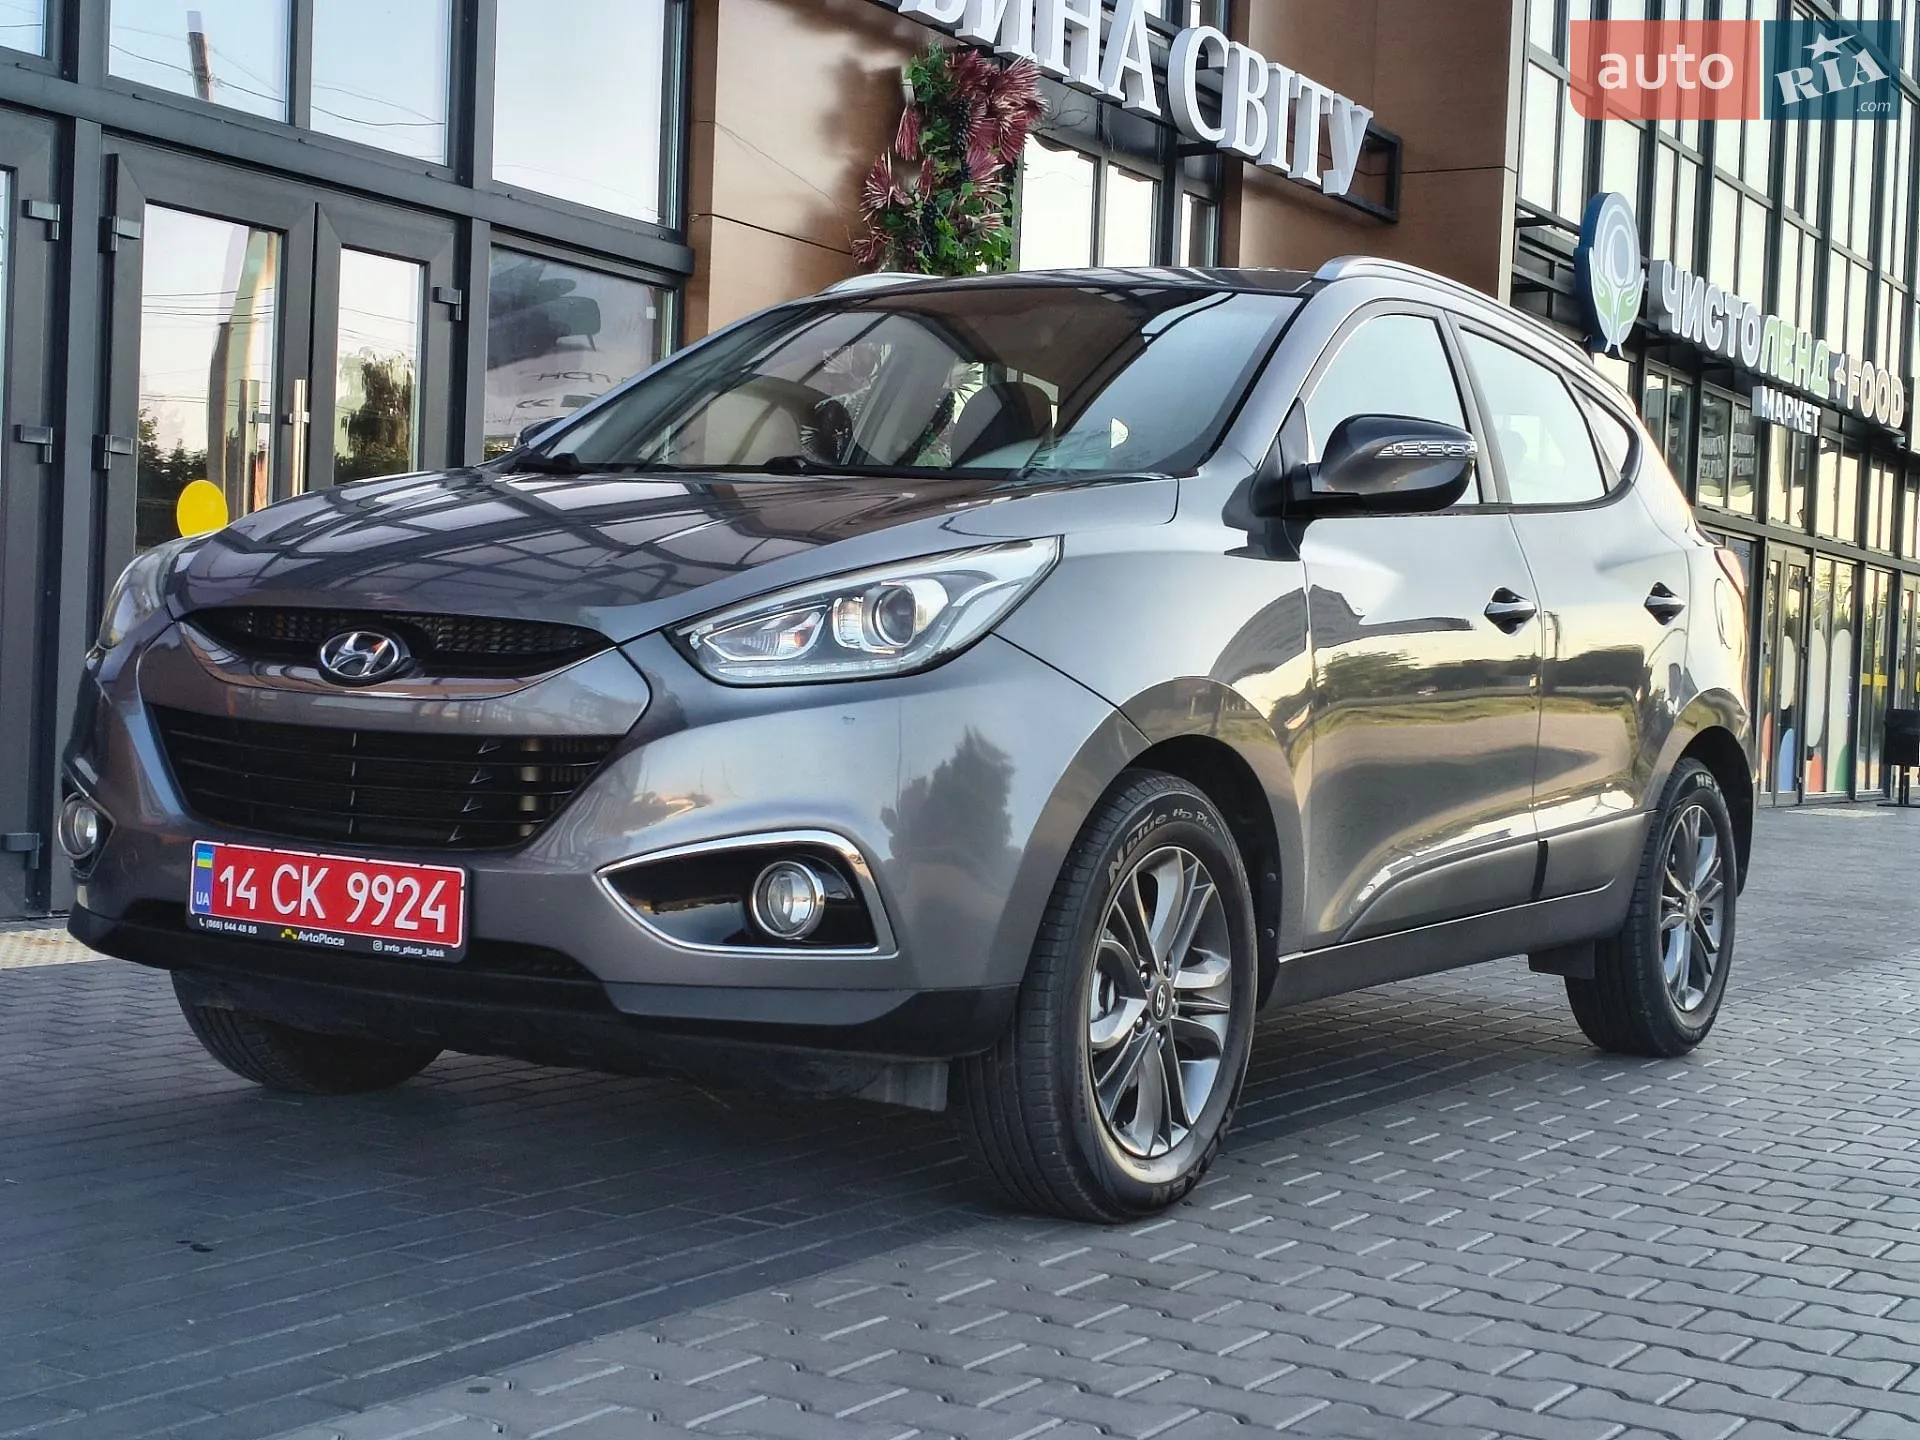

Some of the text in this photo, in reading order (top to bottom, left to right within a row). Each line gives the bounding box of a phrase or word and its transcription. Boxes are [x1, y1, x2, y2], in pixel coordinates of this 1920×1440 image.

[1169, 26, 1374, 196] СВІТУ
[1661, 259, 1830, 400] ЧИСТОЛЕНД
[1760, 385, 1822, 436] МАРКЕТ
[196, 891, 210, 906] UA
[219, 863, 447, 933] 14 CK 9924
[298, 930, 345, 947] AvtoPlace
